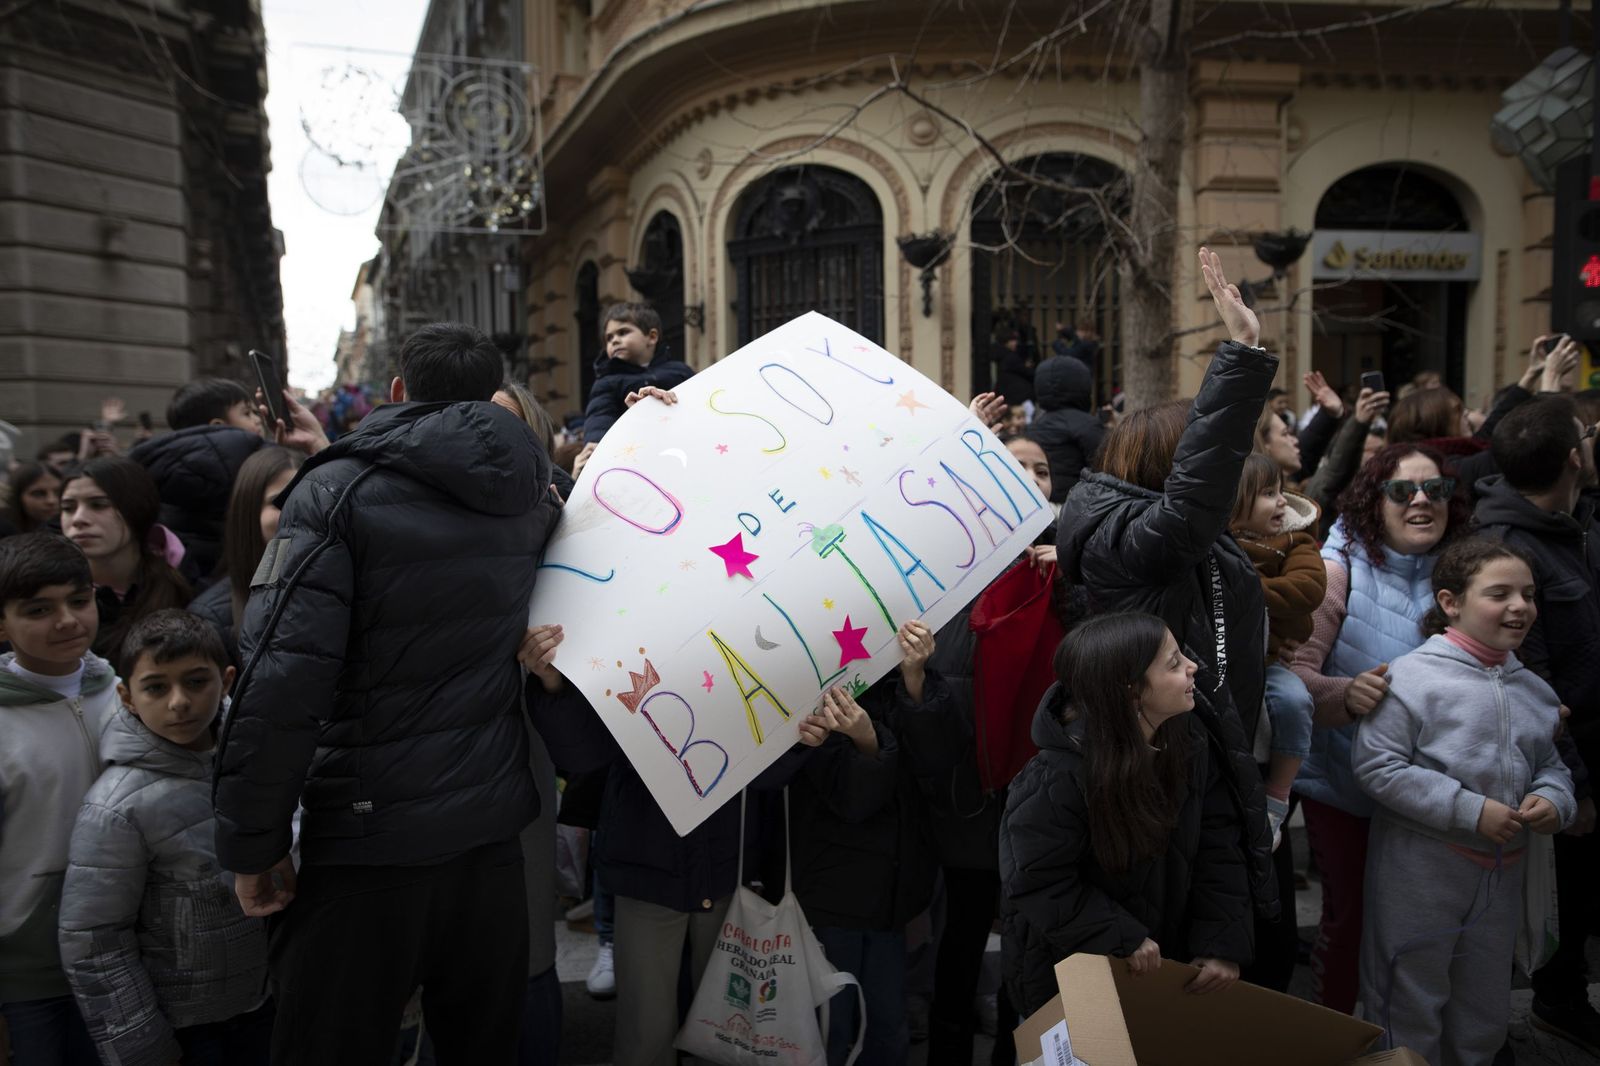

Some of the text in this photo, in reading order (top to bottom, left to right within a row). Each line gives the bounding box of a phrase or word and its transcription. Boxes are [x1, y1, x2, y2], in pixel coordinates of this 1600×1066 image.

[1354, 246, 1470, 270] Santander
[708, 338, 894, 454] SOY
[737, 488, 797, 537] DE
[641, 429, 1043, 799] BALTASAR
